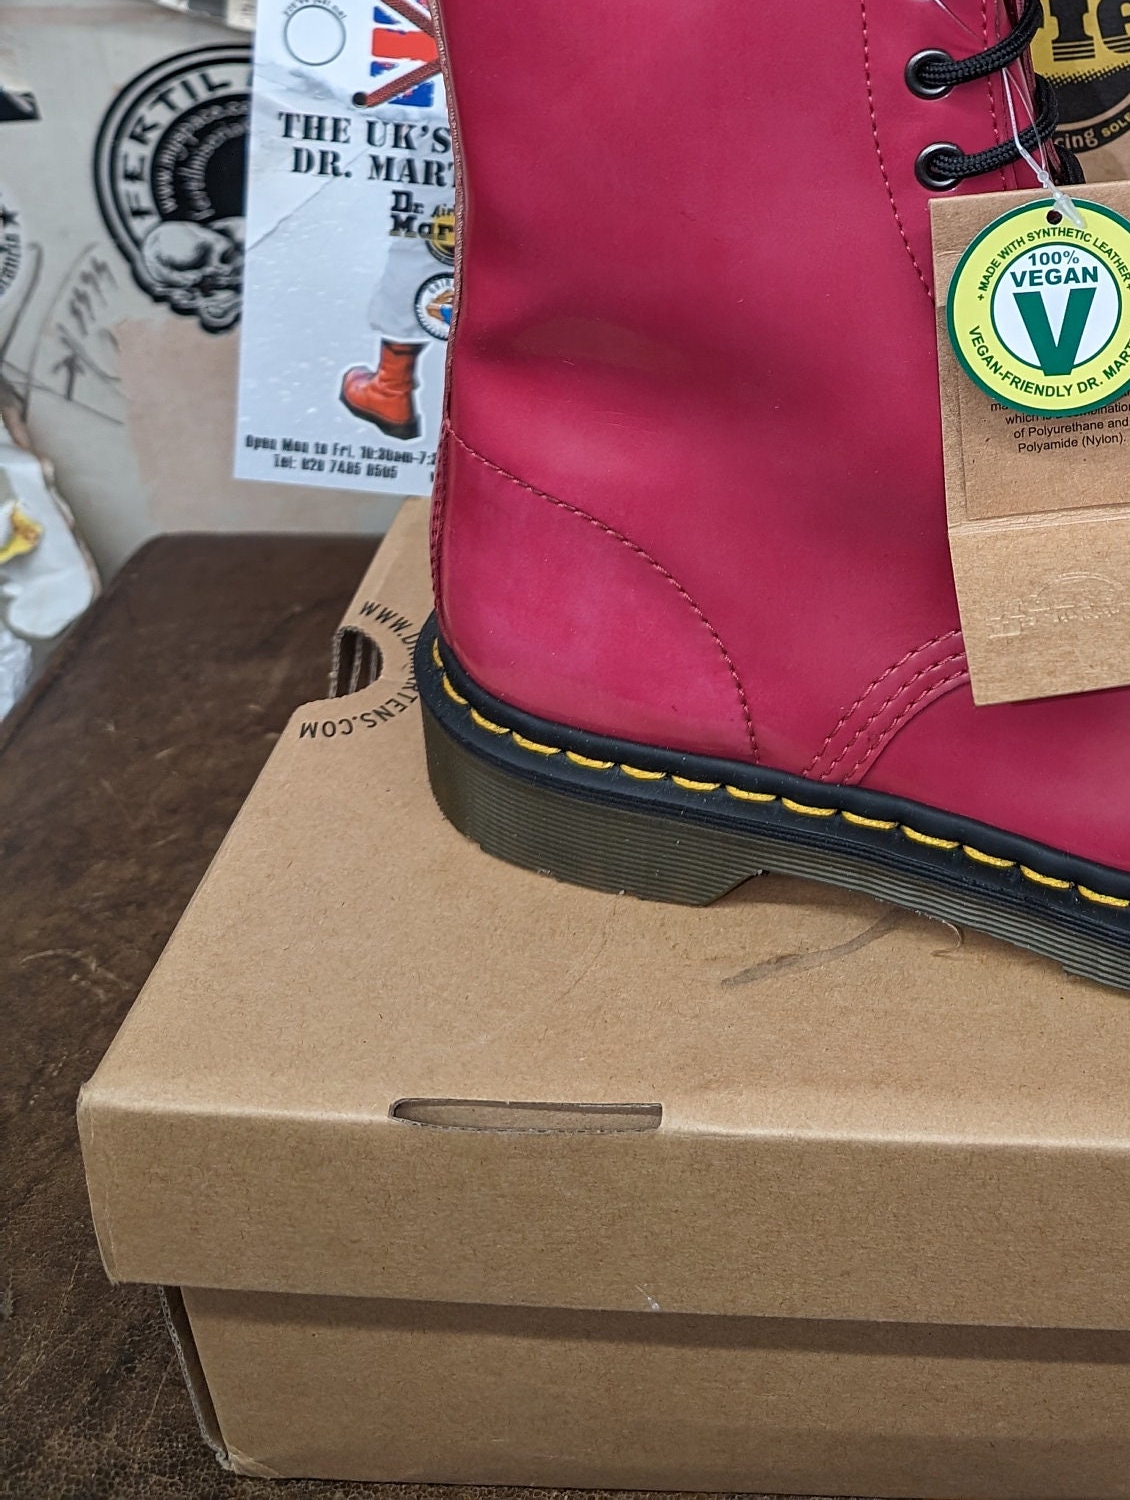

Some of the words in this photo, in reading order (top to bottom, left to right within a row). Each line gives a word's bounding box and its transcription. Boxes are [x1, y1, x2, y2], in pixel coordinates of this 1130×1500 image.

[277, 112, 351, 143] THE
[291, 146, 354, 177] DR.
[389, 212, 456, 241] Mar
[978, 257, 1002, 293] MADE
[999, 235, 1027, 261] WITH
[1026, 226, 1093, 243] SYNTHETIC
[1028, 250, 1080, 268] 100%
[1010, 265, 1099, 288] VEGAN
[1012, 287, 1098, 378] V
[968, 324, 1074, 398] VEGAN-FRIENDLY
[1077, 376, 1104, 394] DR.
[1005, 412, 1040, 426] which
[1013, 426, 1026, 439] of
[1028, 419, 1105, 438] Polyurethane
[1107, 416, 1130, 429] and
[314, 442, 328, 455] to
[1017, 436, 1079, 454] Polyamide
[1081, 432, 1127, 449] (Nylon).
